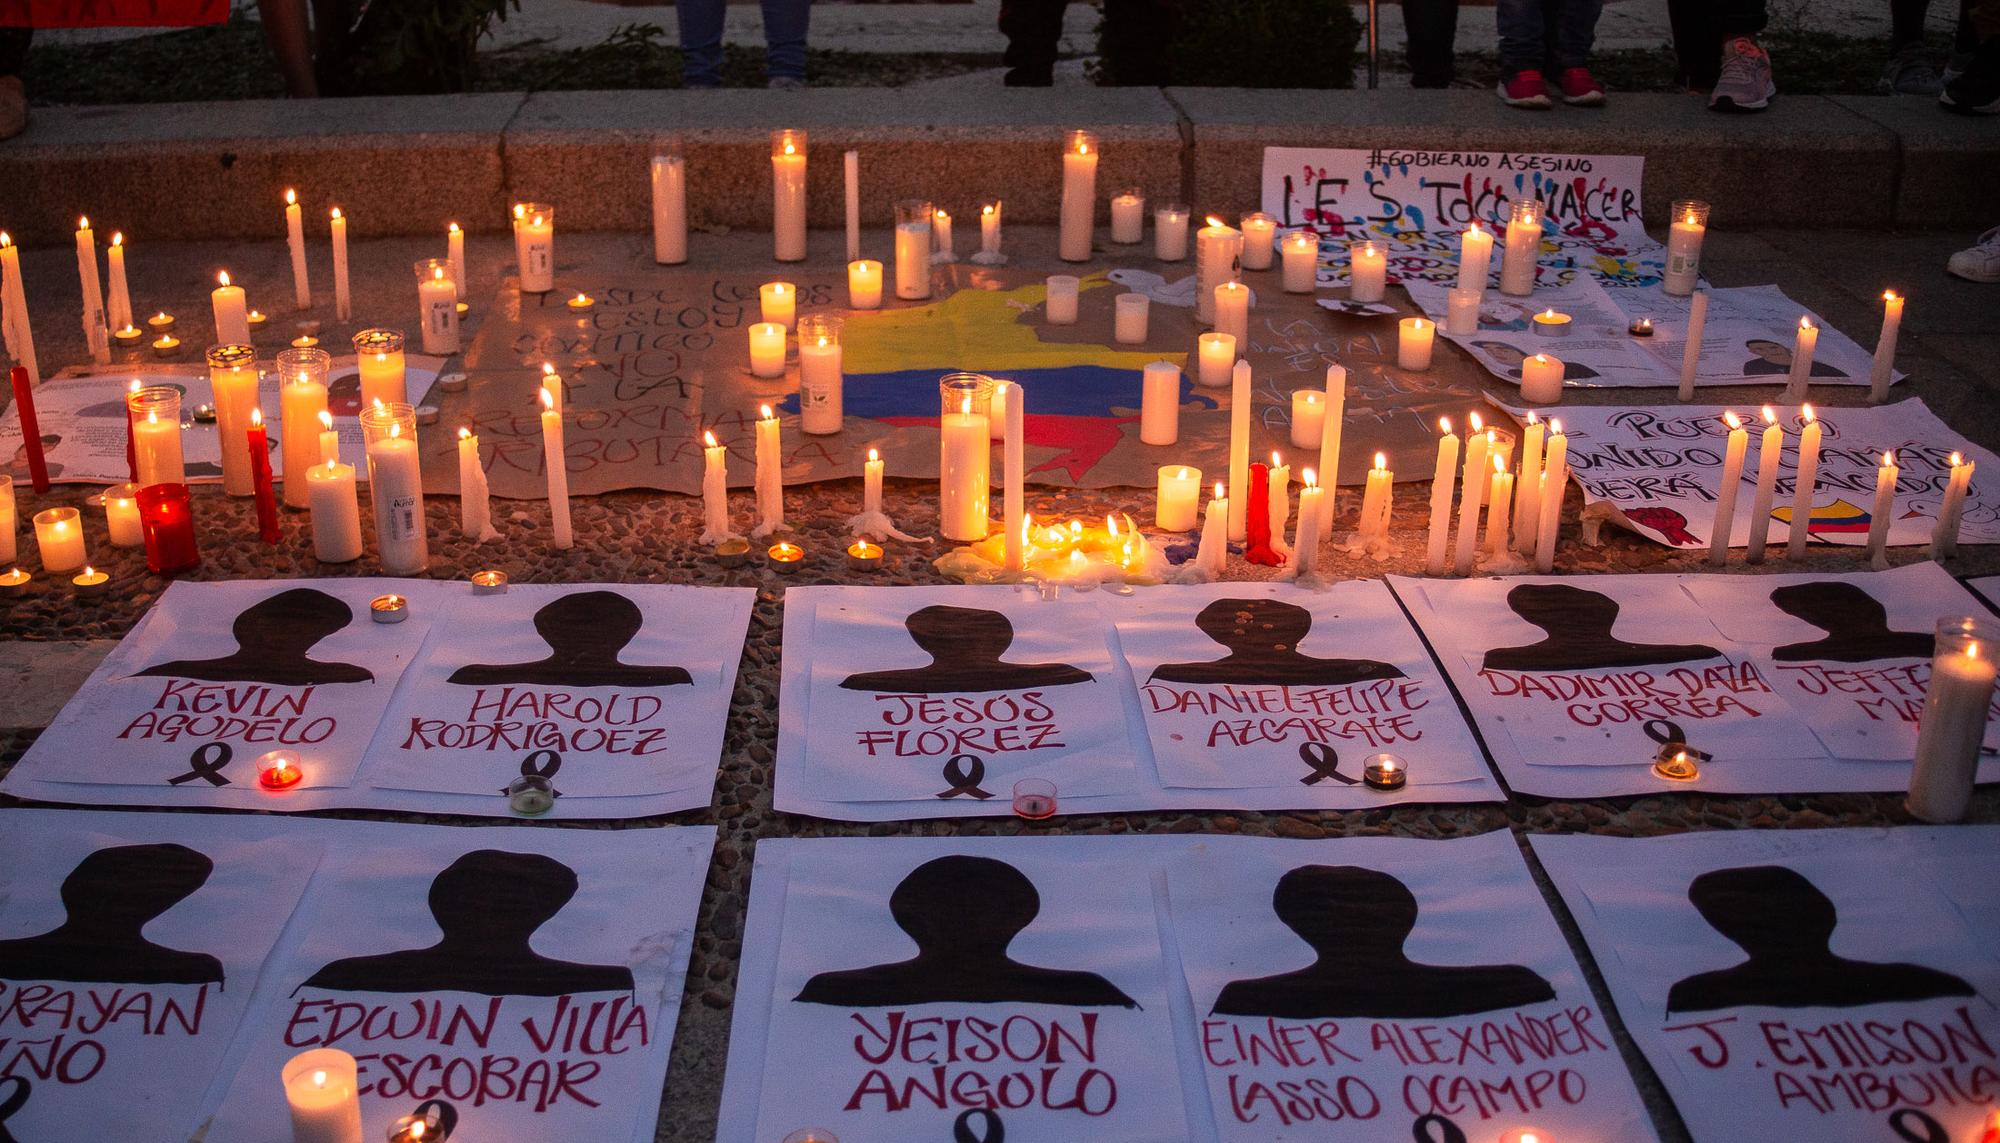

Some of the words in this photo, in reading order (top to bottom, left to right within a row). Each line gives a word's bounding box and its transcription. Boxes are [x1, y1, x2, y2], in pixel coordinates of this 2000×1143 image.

[1498, 154, 1593, 172] ASESINO
[1284, 174, 1402, 228] LES
[153, 680, 316, 717] KEVIN
[467, 687, 662, 726] HAROLD
[1477, 669, 1682, 702] DADIMIR
[1665, 660, 1772, 699] DAZA
[116, 711, 337, 745] AGUDELO
[1567, 695, 1763, 727] CORREA
[0, 978, 209, 1036] RAYAN
[283, 997, 504, 1049] EDWIN
[520, 995, 649, 1055] VILLA
[0, 1033, 107, 1084] ÑO
[851, 1011, 1099, 1065] YEISON
[1201, 1016, 1361, 1067] EINER
[1371, 1005, 1608, 1066] ALEXANDER
[1759, 1006, 1997, 1070] EMILSON
[843, 1065, 1118, 1116] ANGOLO
[1228, 1073, 1381, 1125] LASSO
[1402, 1067, 1587, 1120] OCAMPO
